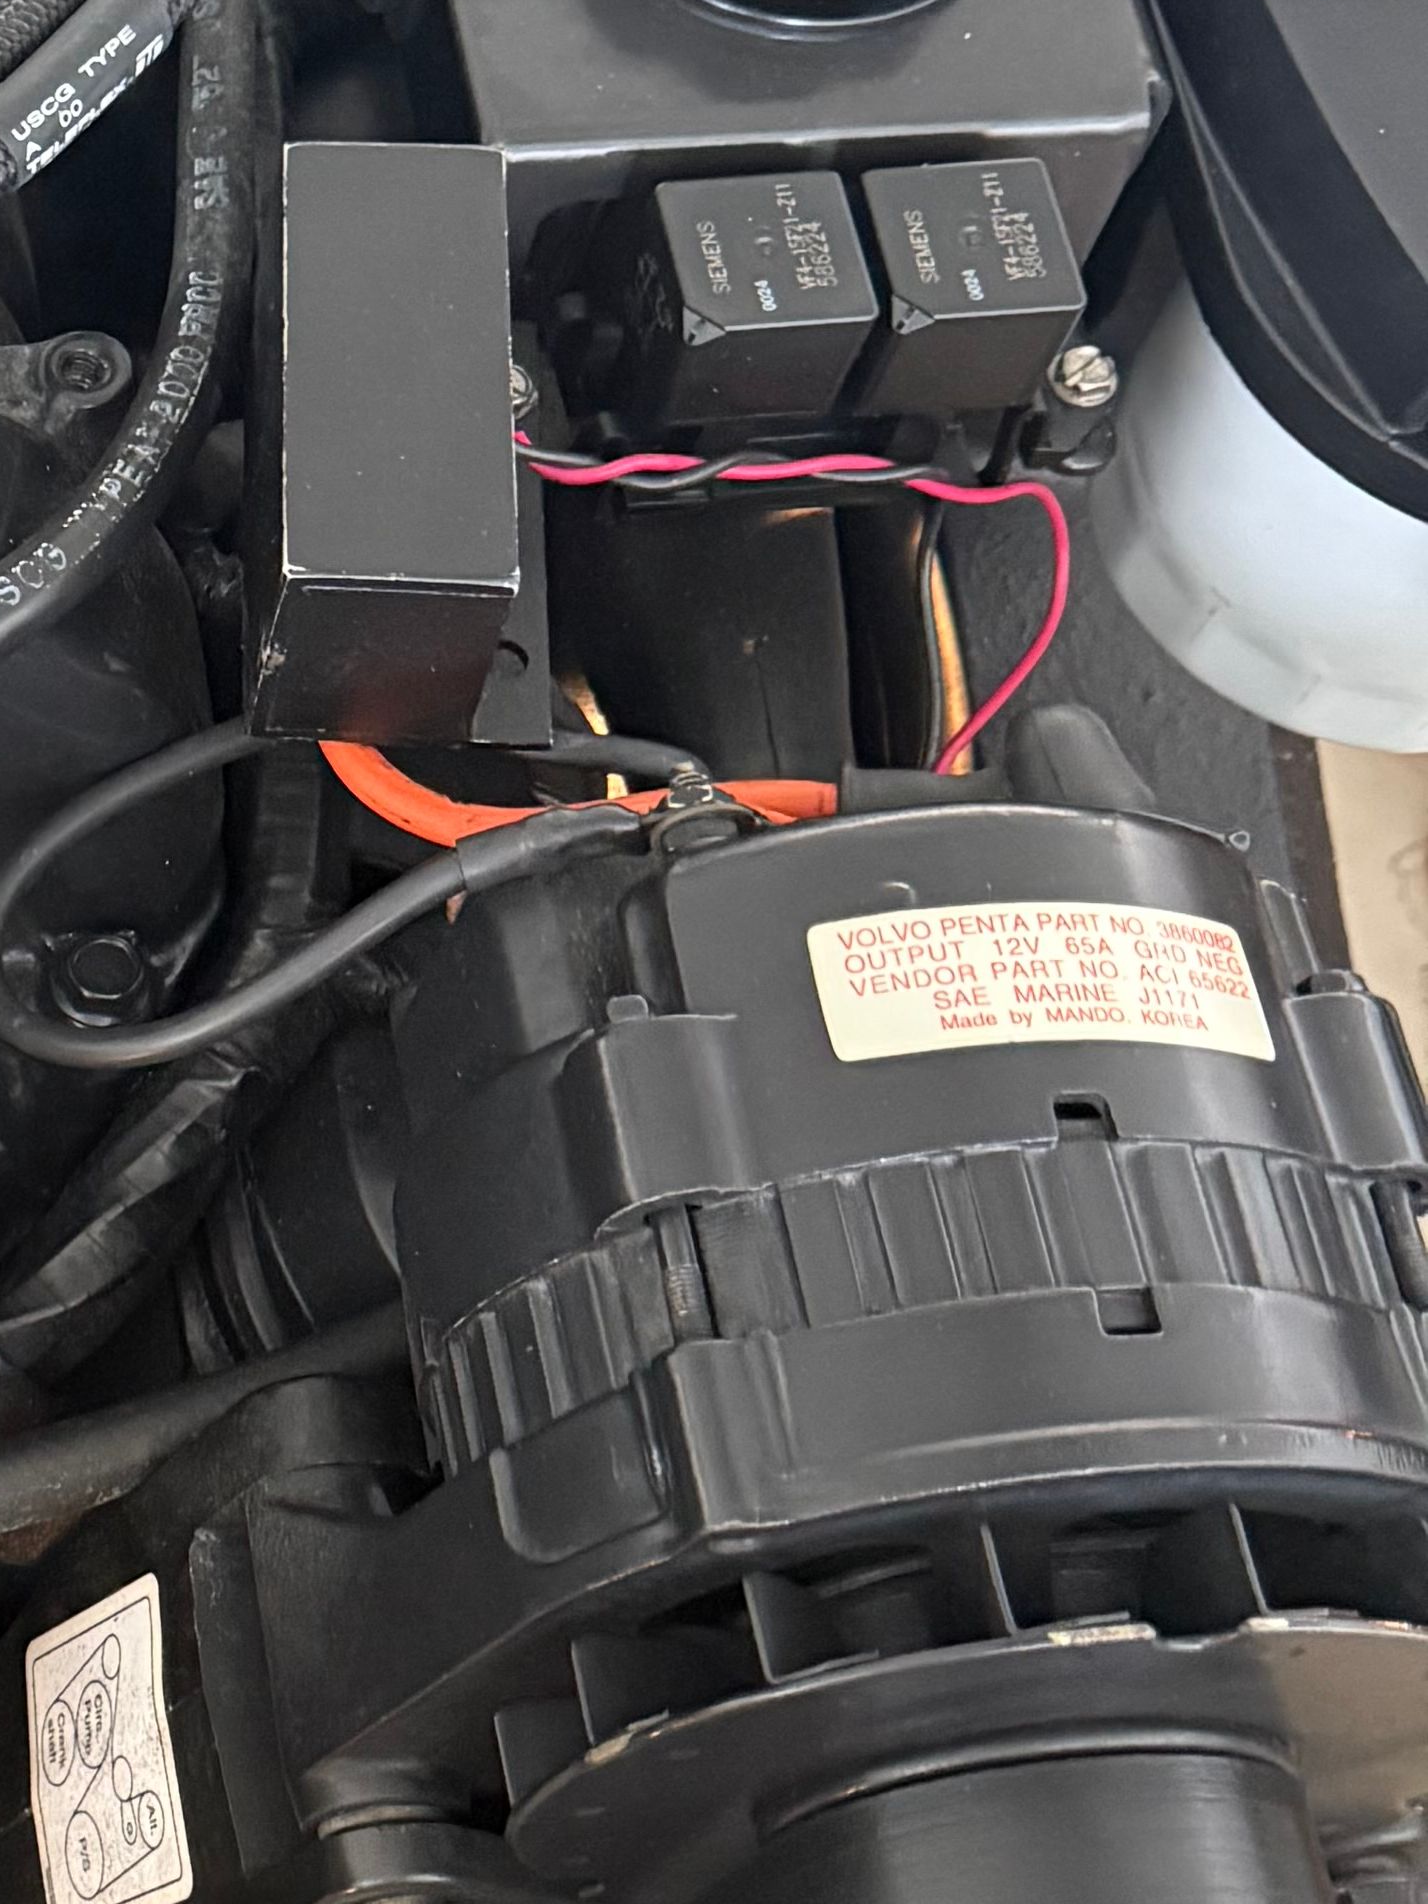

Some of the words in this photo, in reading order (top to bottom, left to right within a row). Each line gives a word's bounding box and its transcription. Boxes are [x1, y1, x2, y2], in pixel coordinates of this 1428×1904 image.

[11, 82, 76, 142] USCG
[77, 23, 137, 78] TYPE
[696, 220, 731, 295] SIEMENS
[903, 209, 940, 284] SIEMENS
[837, 920, 931, 950] VOLVO
[940, 913, 1029, 936] PENTA
[1037, 912, 1101, 932] PART
[845, 941, 964, 973] OUTPUT
[993, 937, 1039, 956] 12V
[1065, 937, 1113, 955] 65A
[1196, 949, 1243, 976] NEG
[849, 963, 977, 997] VENDOR
[991, 959, 1064, 980] PART
[1189, 971, 1251, 1000] 65622
[933, 986, 991, 1010] SAE
[1014, 983, 1118, 1003] MARINE
[1139, 988, 1199, 1009] J1171
[940, 1010, 997, 1031] Made
[1009, 1008, 1033, 1028] by
[1142, 1010, 1209, 1031] KOREA
